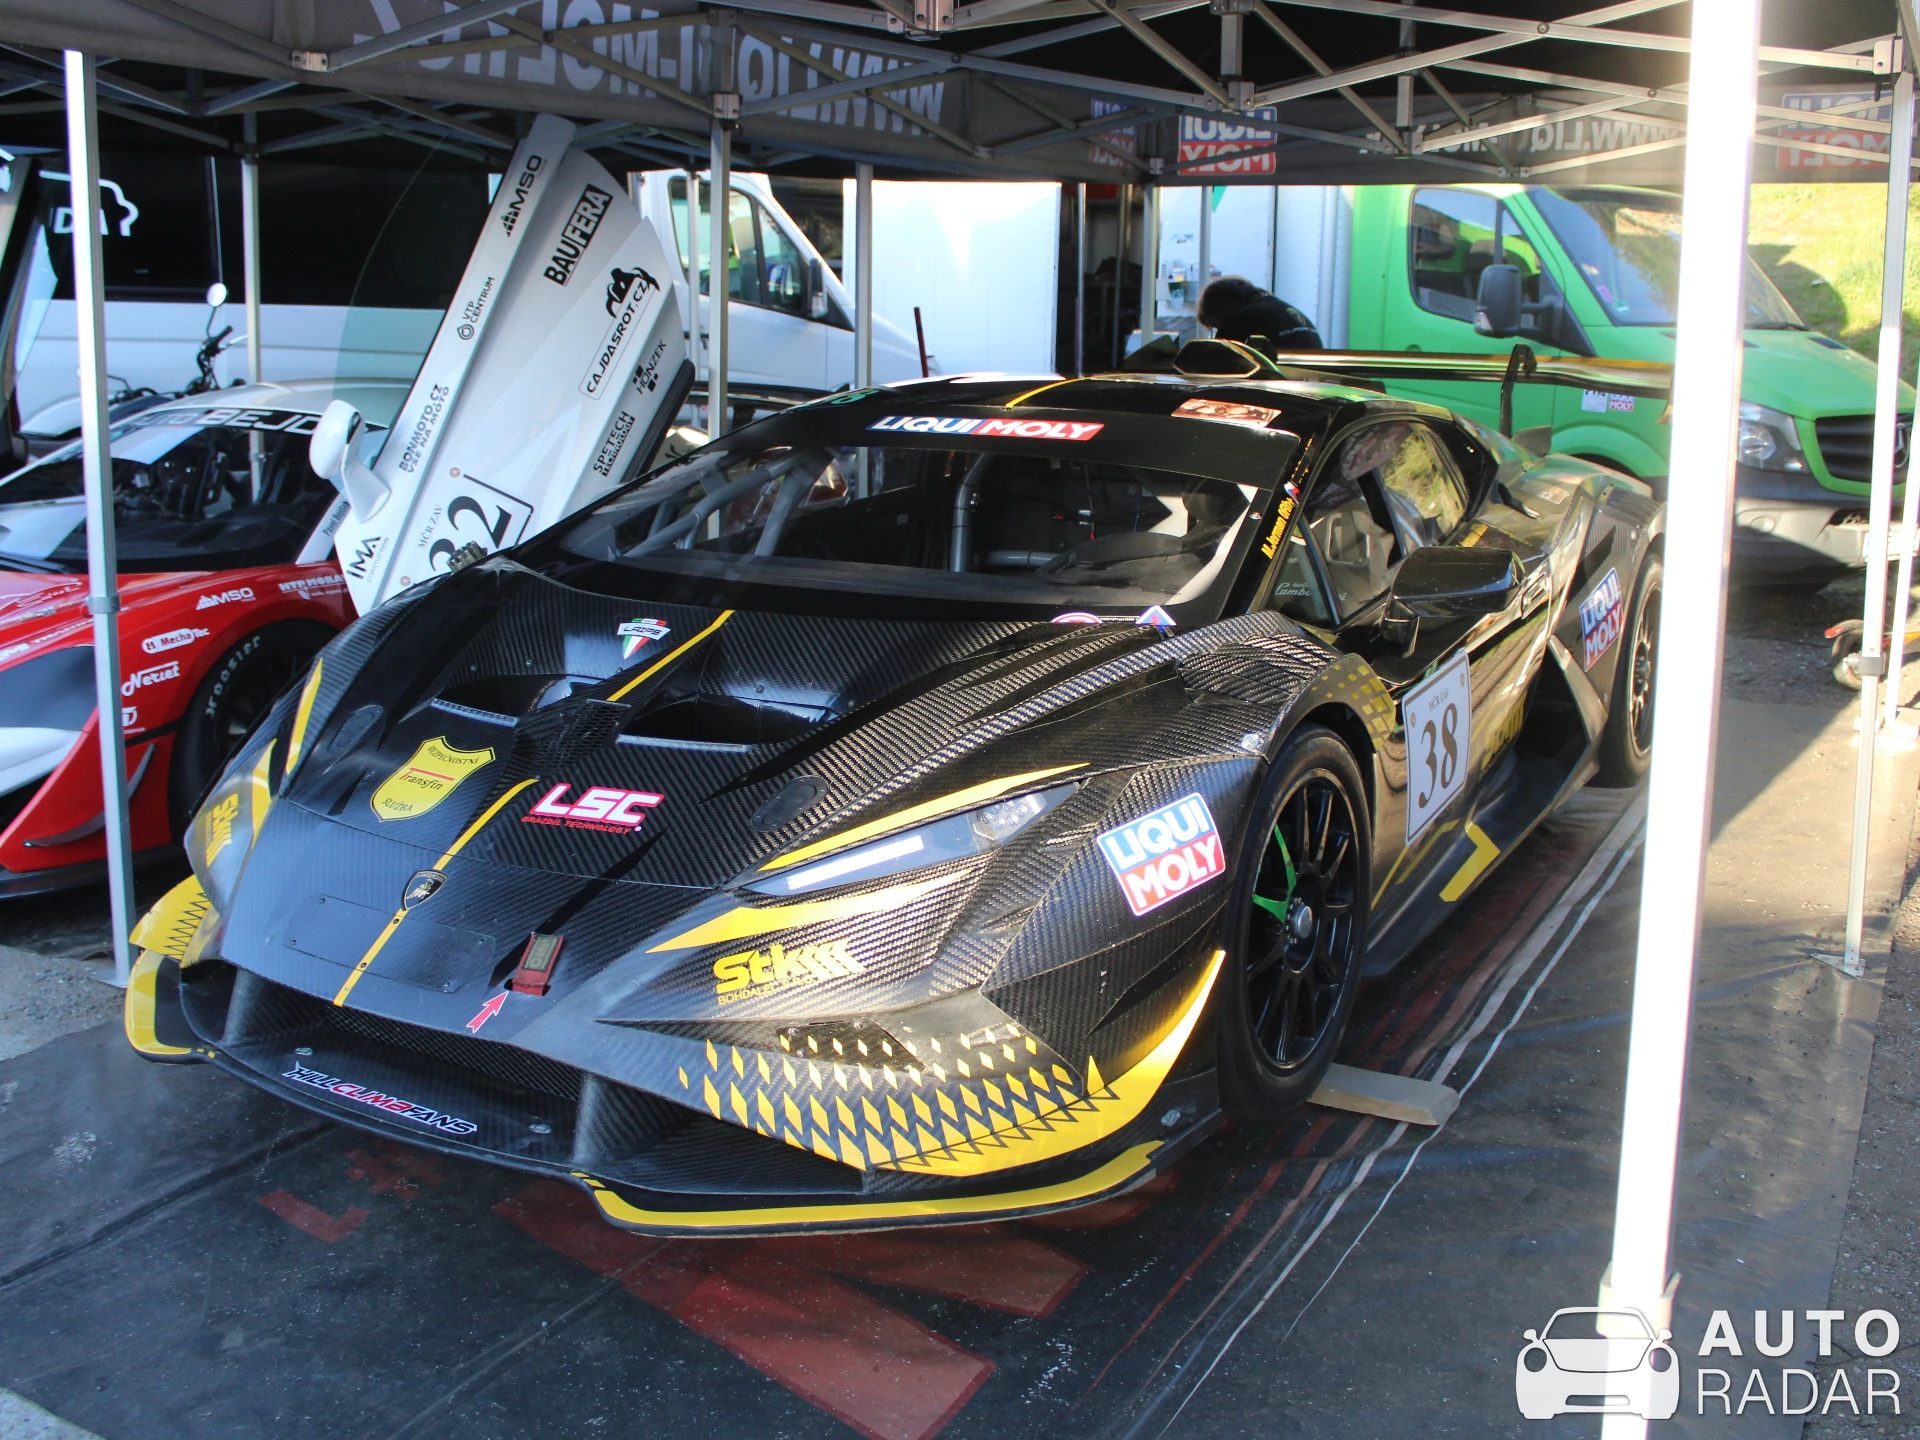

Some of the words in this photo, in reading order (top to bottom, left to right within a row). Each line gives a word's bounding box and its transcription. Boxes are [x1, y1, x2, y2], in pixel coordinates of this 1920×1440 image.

[544, 184, 613, 286] BAUFERA
[462, 301, 474, 320] VTP
[470, 276, 495, 323] CENTRUM
[587, 282, 648, 393] CAJDASROT.CZ
[636, 339, 666, 394] HONZEK
[399, 383, 442, 472] BONMOTO.CZ
[420, 429, 432, 448] NA
[430, 386, 450, 426] MOTO
[593, 410, 629, 473] SPETECH
[871, 415, 982, 434] LIQUI
[977, 419, 1101, 439] MOLY
[305, 574, 346, 587] MORA
[1581, 574, 1618, 634] LIQUI
[1585, 605, 1621, 665] MOLY
[1418, 703, 1458, 809] 38
[381, 797, 413, 812] SLUŽBA
[521, 815, 561, 826] BRAZDIL
[564, 820, 631, 834] TECHNOLOGY
[530, 783, 664, 827] LSC
[1104, 799, 1210, 870] LIQUI
[1125, 834, 1217, 908] MOLY
[717, 983, 780, 1006] BOHDALEC
